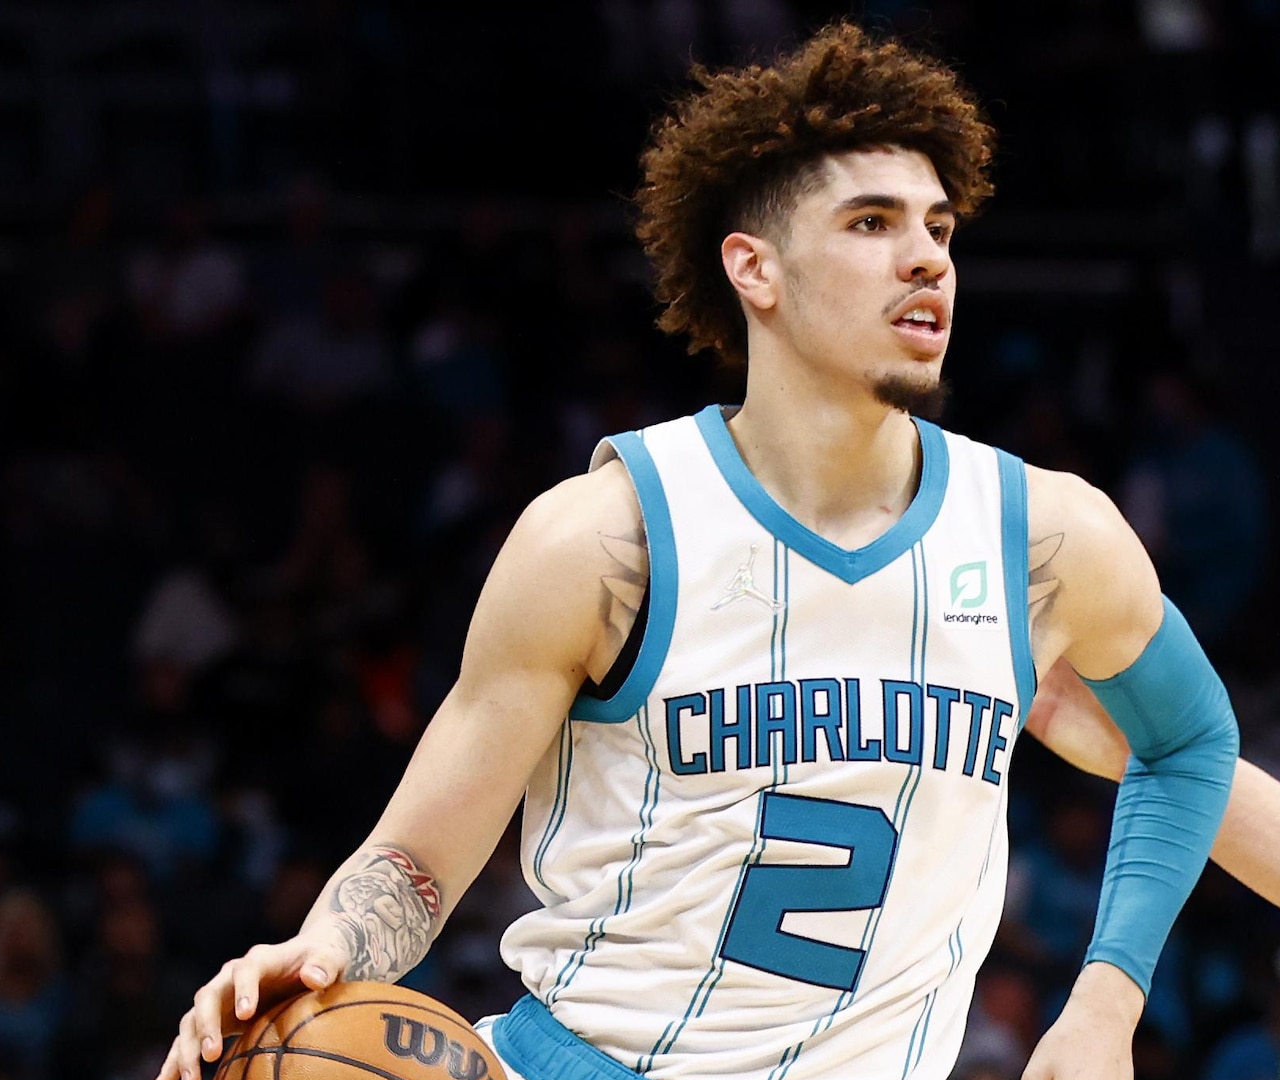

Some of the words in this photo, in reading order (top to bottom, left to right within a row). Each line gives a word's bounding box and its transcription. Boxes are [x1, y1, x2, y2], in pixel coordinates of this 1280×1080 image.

[943, 611, 998, 625] lendingtree
[663, 678, 1014, 786] CHARLOTTE
[719, 791, 899, 992] 2
